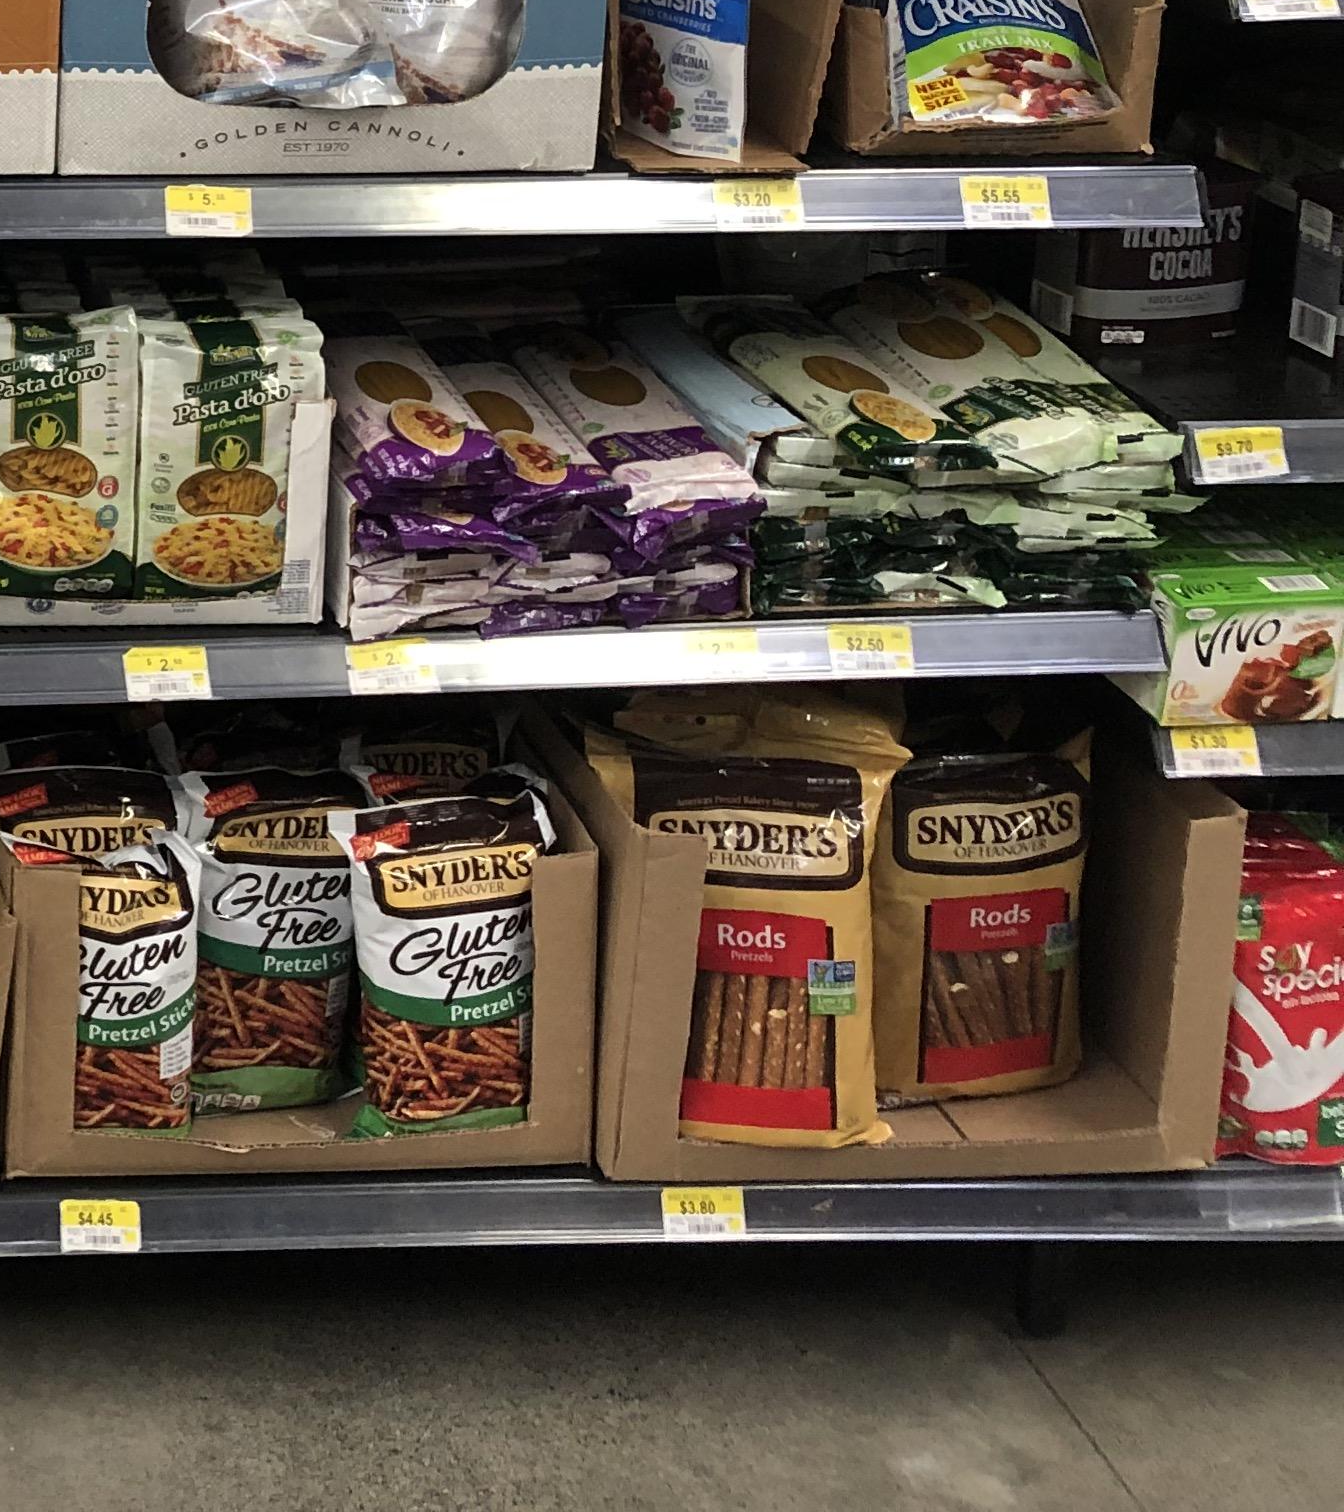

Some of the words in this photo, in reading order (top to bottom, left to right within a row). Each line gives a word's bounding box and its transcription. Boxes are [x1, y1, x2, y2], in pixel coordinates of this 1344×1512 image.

[916, 78, 954, 94] NEW
[924, 92, 965, 112] SIZE
[733, 192, 772, 208] $3.20
[980, 188, 1021, 204] $5.55
[916, 800, 1076, 847] SNYDER'S
[716, 923, 786, 949] Rods
[264, 954, 328, 972] Pretzel
[731, 950, 773, 963] Pretzels
[439, 954, 522, 1005] Free
[679, 1200, 716, 1217] $3.80
[77, 1211, 114, 1227] $4.45
